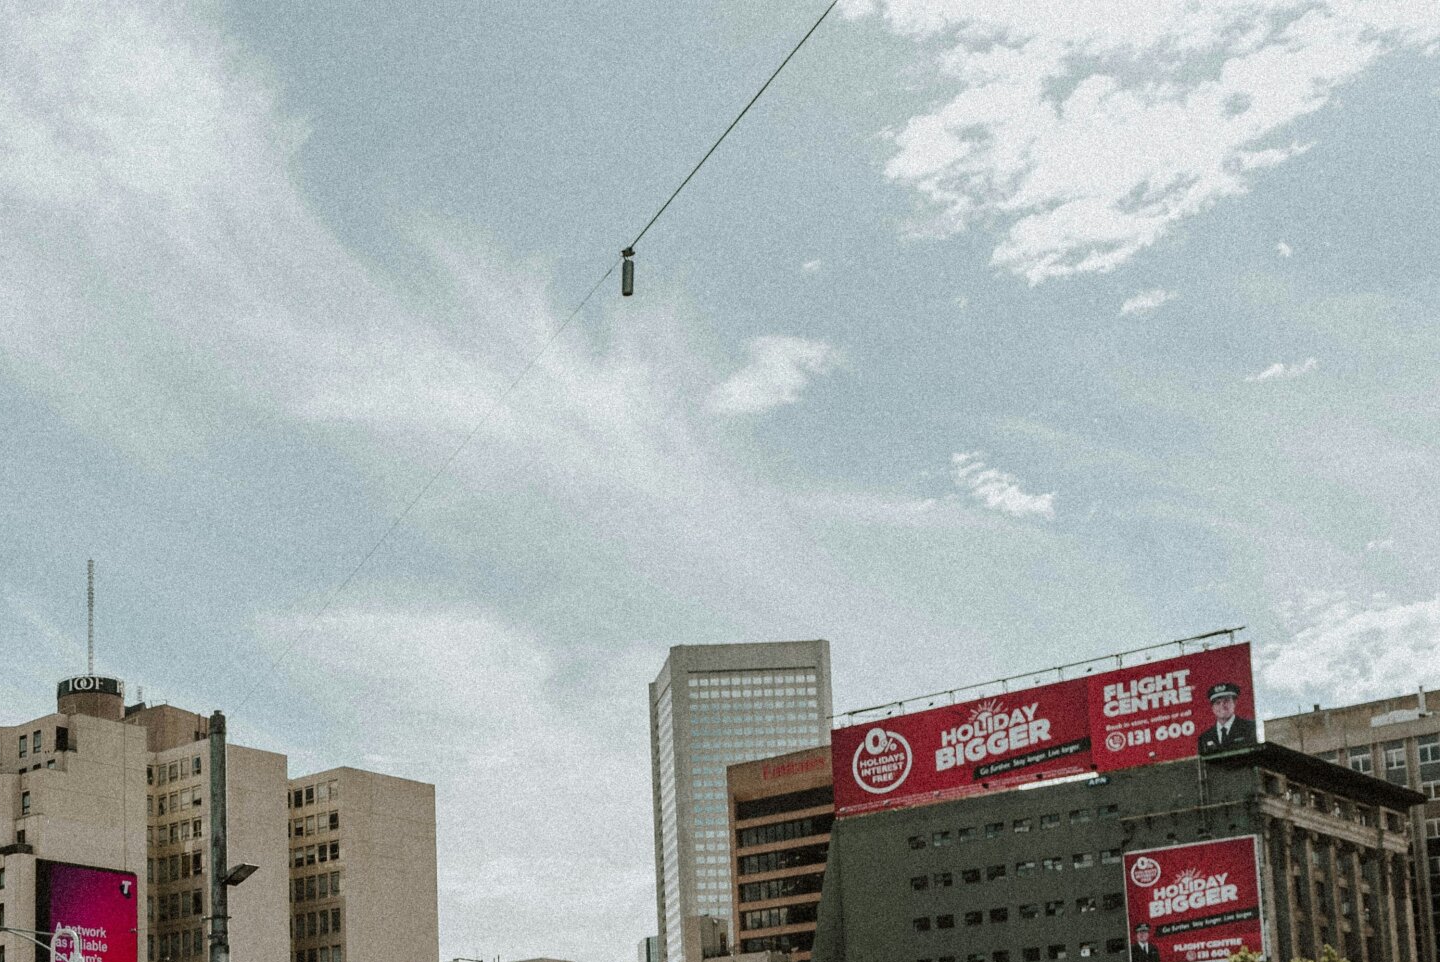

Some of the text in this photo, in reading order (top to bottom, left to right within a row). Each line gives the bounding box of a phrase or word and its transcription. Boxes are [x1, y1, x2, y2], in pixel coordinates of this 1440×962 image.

[1103, 669, 1190, 702] FLIGHT
[1103, 685, 1193, 718] CENTRE
[941, 702, 1039, 747] HOLIDAY
[1127, 720, 1195, 747] 131 600
[865, 727, 898, 756] 0%
[935, 718, 1052, 772] BIGGER
[860, 752, 905, 769] HOLIDAYS
[861, 761, 904, 778] INTEREST
[872, 772, 894, 784] FREE
[1153, 872, 1228, 900] HOLIDAY
[1149, 884, 1238, 919] BIGGER
[70, 938, 108, 952] rliable
